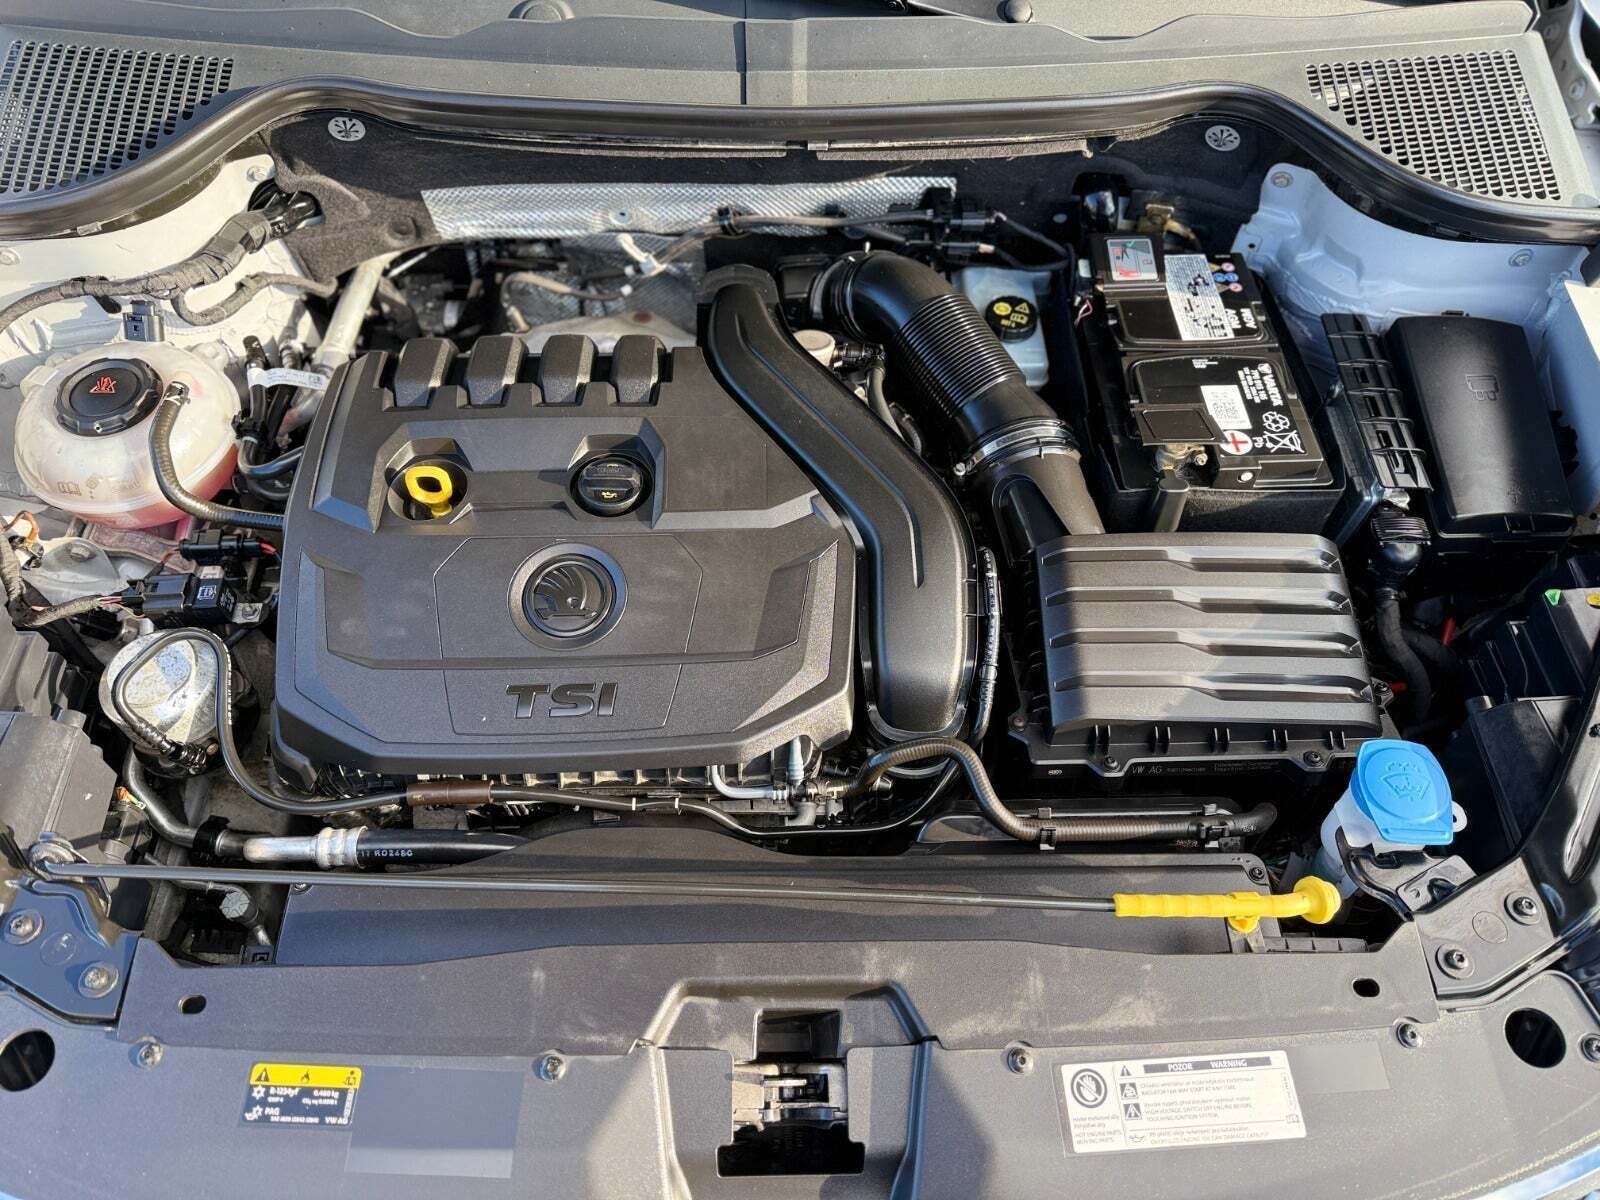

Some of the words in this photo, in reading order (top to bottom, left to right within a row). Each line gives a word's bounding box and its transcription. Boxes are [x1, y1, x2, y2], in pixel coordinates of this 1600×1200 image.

[1224, 307, 1242, 329] AGM
[1263, 374, 1284, 407] VARTA
[1252, 436, 1264, 448] Pb
[505, 682, 619, 719] TSI
[1131, 765, 1144, 774] VW
[1148, 765, 1163, 774] AG
[1167, 1062, 1193, 1072] POZOR
[1209, 1059, 1248, 1069] WARNING
[264, 1107, 280, 1116] PAG
[325, 1116, 337, 1124] VW
[337, 1116, 349, 1125] AG
